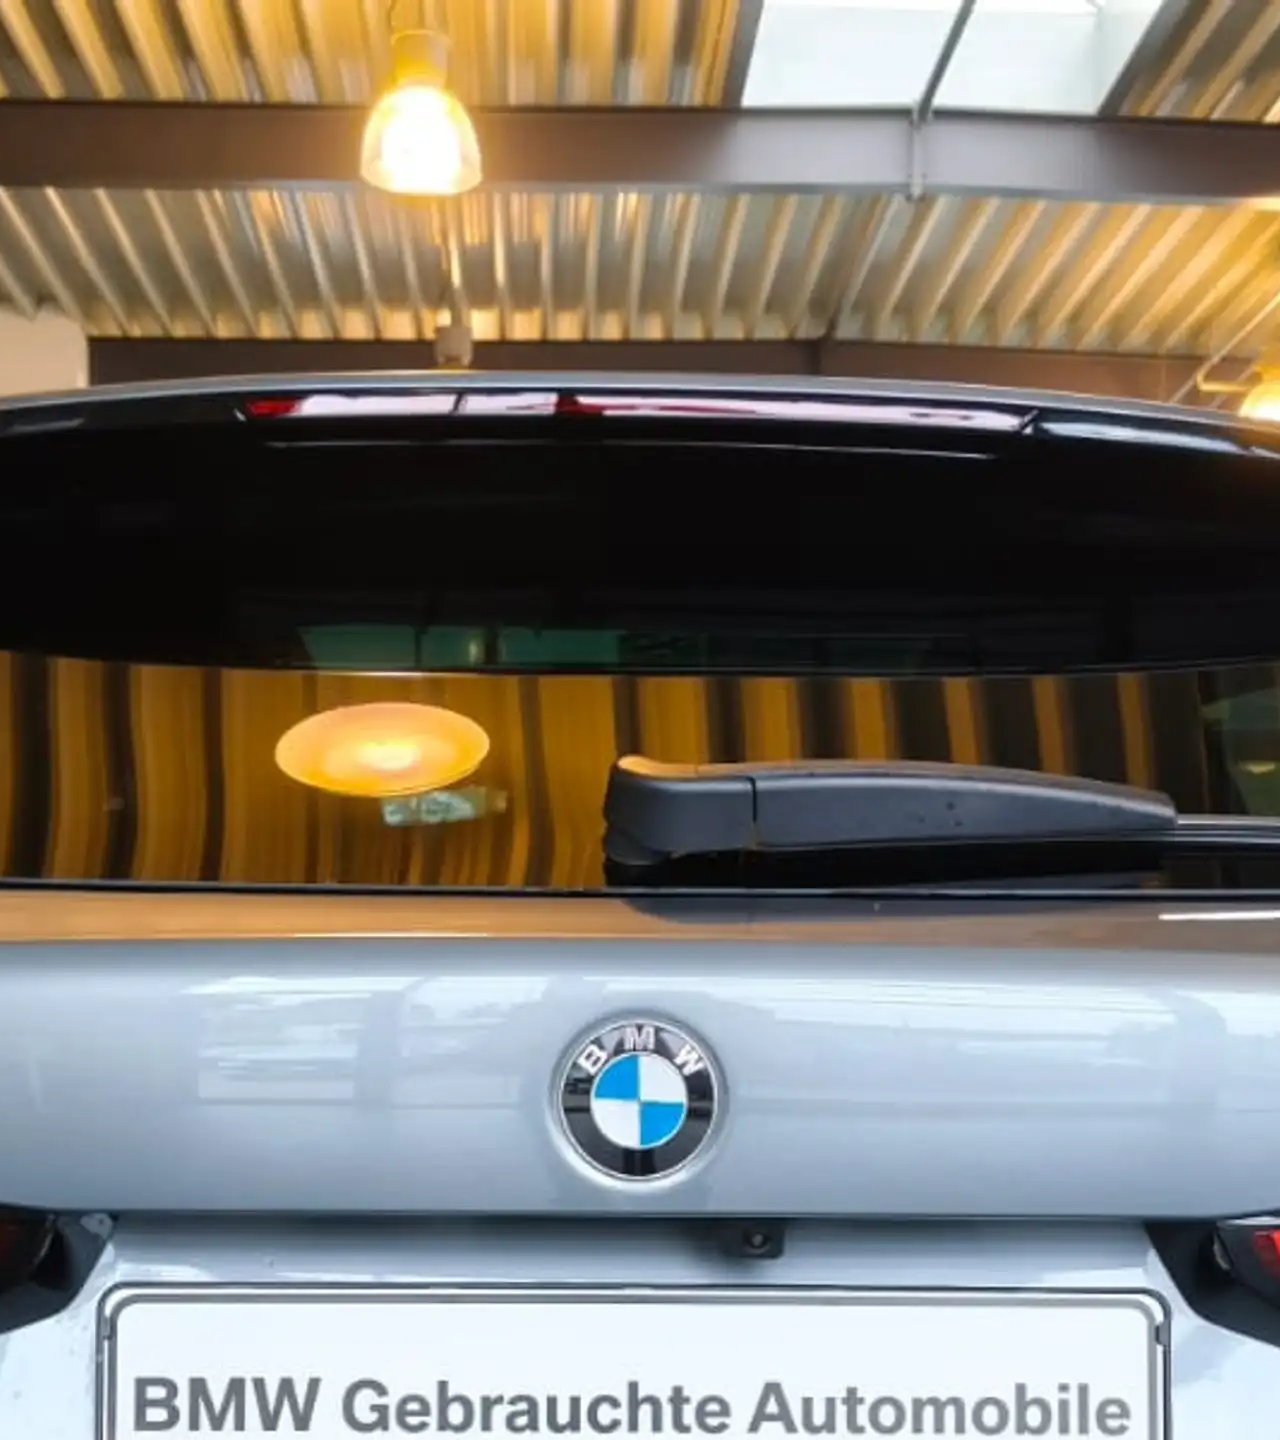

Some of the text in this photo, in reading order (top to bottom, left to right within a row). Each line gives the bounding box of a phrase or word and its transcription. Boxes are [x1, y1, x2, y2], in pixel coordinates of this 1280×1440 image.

[578, 1024, 705, 1077] BMW
[133, 1376, 1131, 1436] BMW Gebrauchte Automobile
